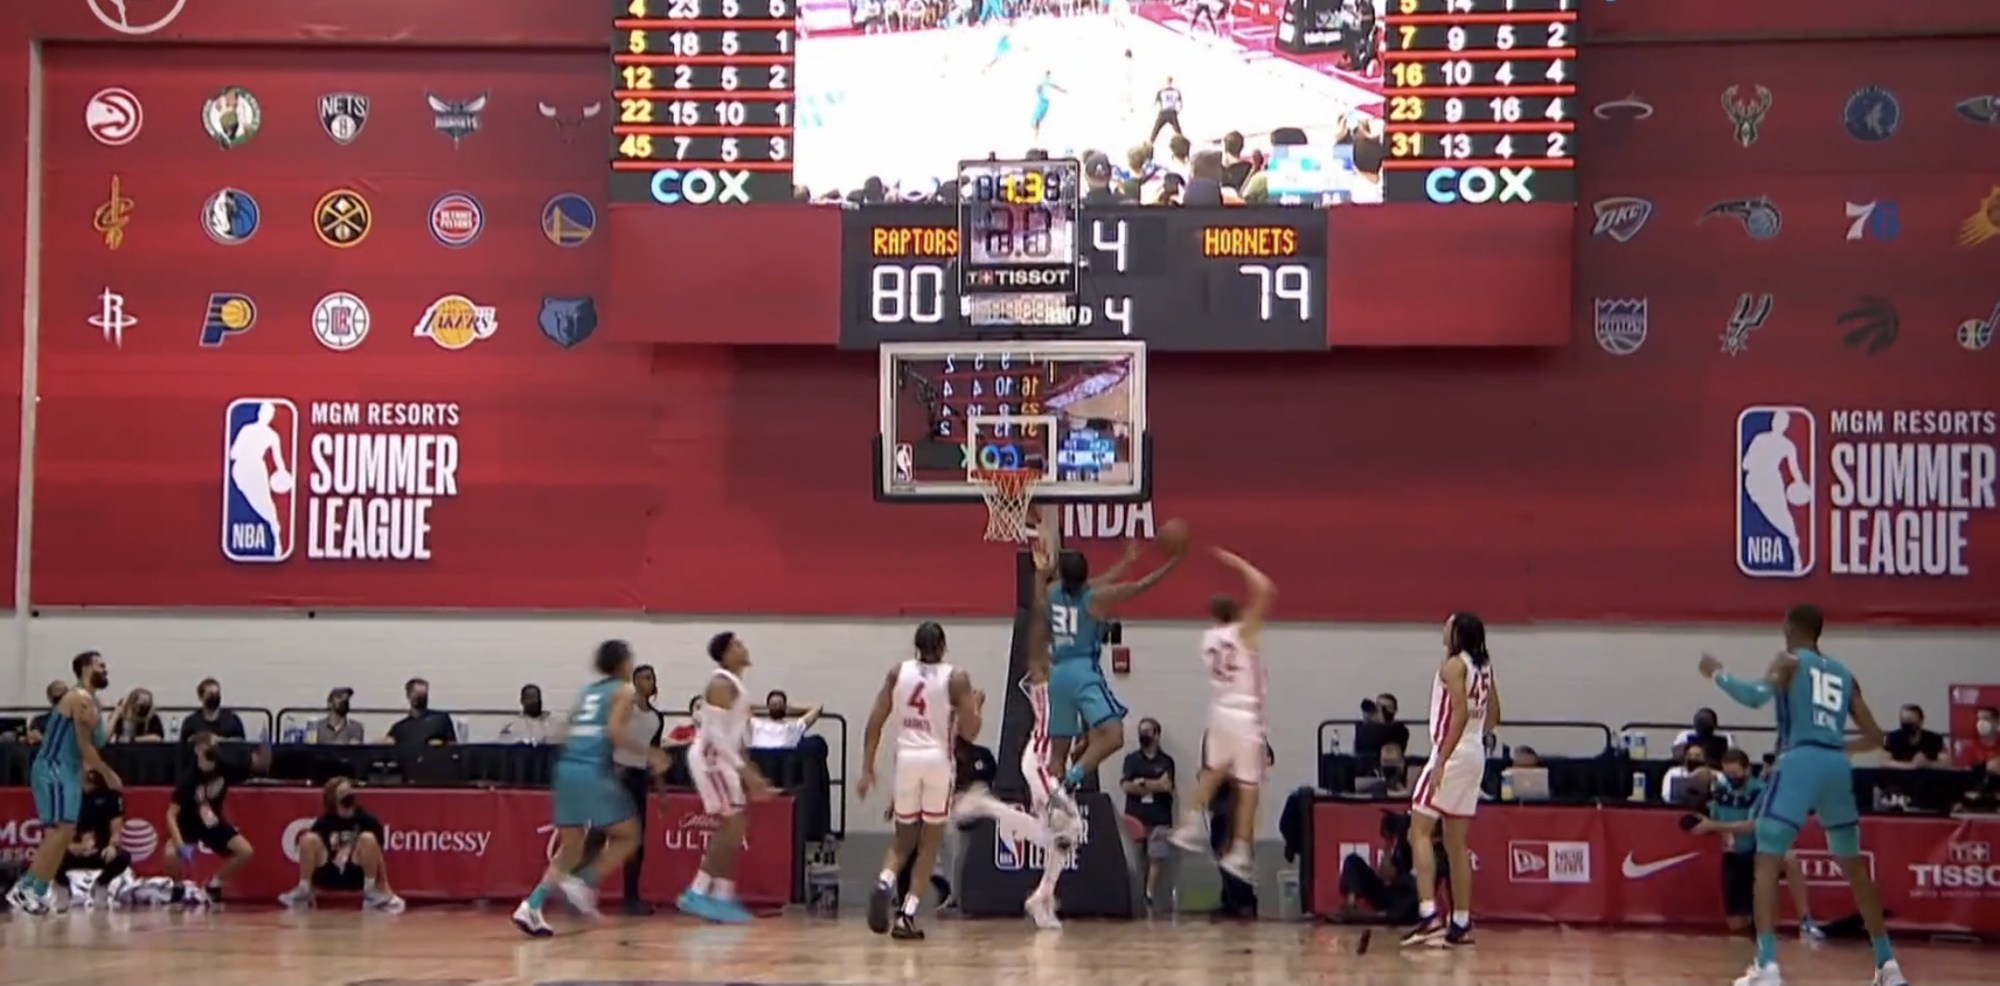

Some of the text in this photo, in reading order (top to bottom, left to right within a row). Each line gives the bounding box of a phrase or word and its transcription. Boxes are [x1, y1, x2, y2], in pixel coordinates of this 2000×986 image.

[628, 0, 646, 18] 4
[668, 0, 700, 19] 23
[629, 29, 788, 56] 5 18 5 1
[1400, 22, 1566, 51] 7 9 5 2
[622, 65, 786, 90] 12 2 5 2
[1392, 58, 1564, 87] 16 10 4 4
[321, 96, 367, 117] NETS
[621, 99, 787, 126] 22 15 10 1
[1390, 97, 1422, 121] 23
[1445, 97, 1463, 122] 9
[1545, 97, 1563, 122] 4
[619, 134, 785, 162] 45 7 5 3
[1391, 132, 1565, 159] 31 13 4 2
[651, 169, 750, 204] COX
[1426, 166, 1533, 203] COX
[1846, 200, 1898, 242] 76
[874, 227, 957, 256] RAPTORS
[1204, 227, 1296, 256] HORNETS
[995, 270, 1070, 286] TISSOT
[872, 265, 942, 322] 80
[1239, 265, 1310, 321] 79
[1105, 297, 1131, 335] 4
[311, 402, 459, 426] MGM RESORTS
[1831, 410, 1995, 434] MGM RESORTS
[310, 432, 458, 495] SUMMER
[1830, 442, 1996, 508] SUMMER
[232, 522, 266, 550] NBA
[308, 497, 432, 560] LEAGUE
[1831, 509, 1969, 576] LEAGUE
[1747, 535, 1784, 564] NBA
[1051, 604, 1078, 635] 31
[908, 681, 926, 716] 4
[1810, 666, 1843, 712] 16
